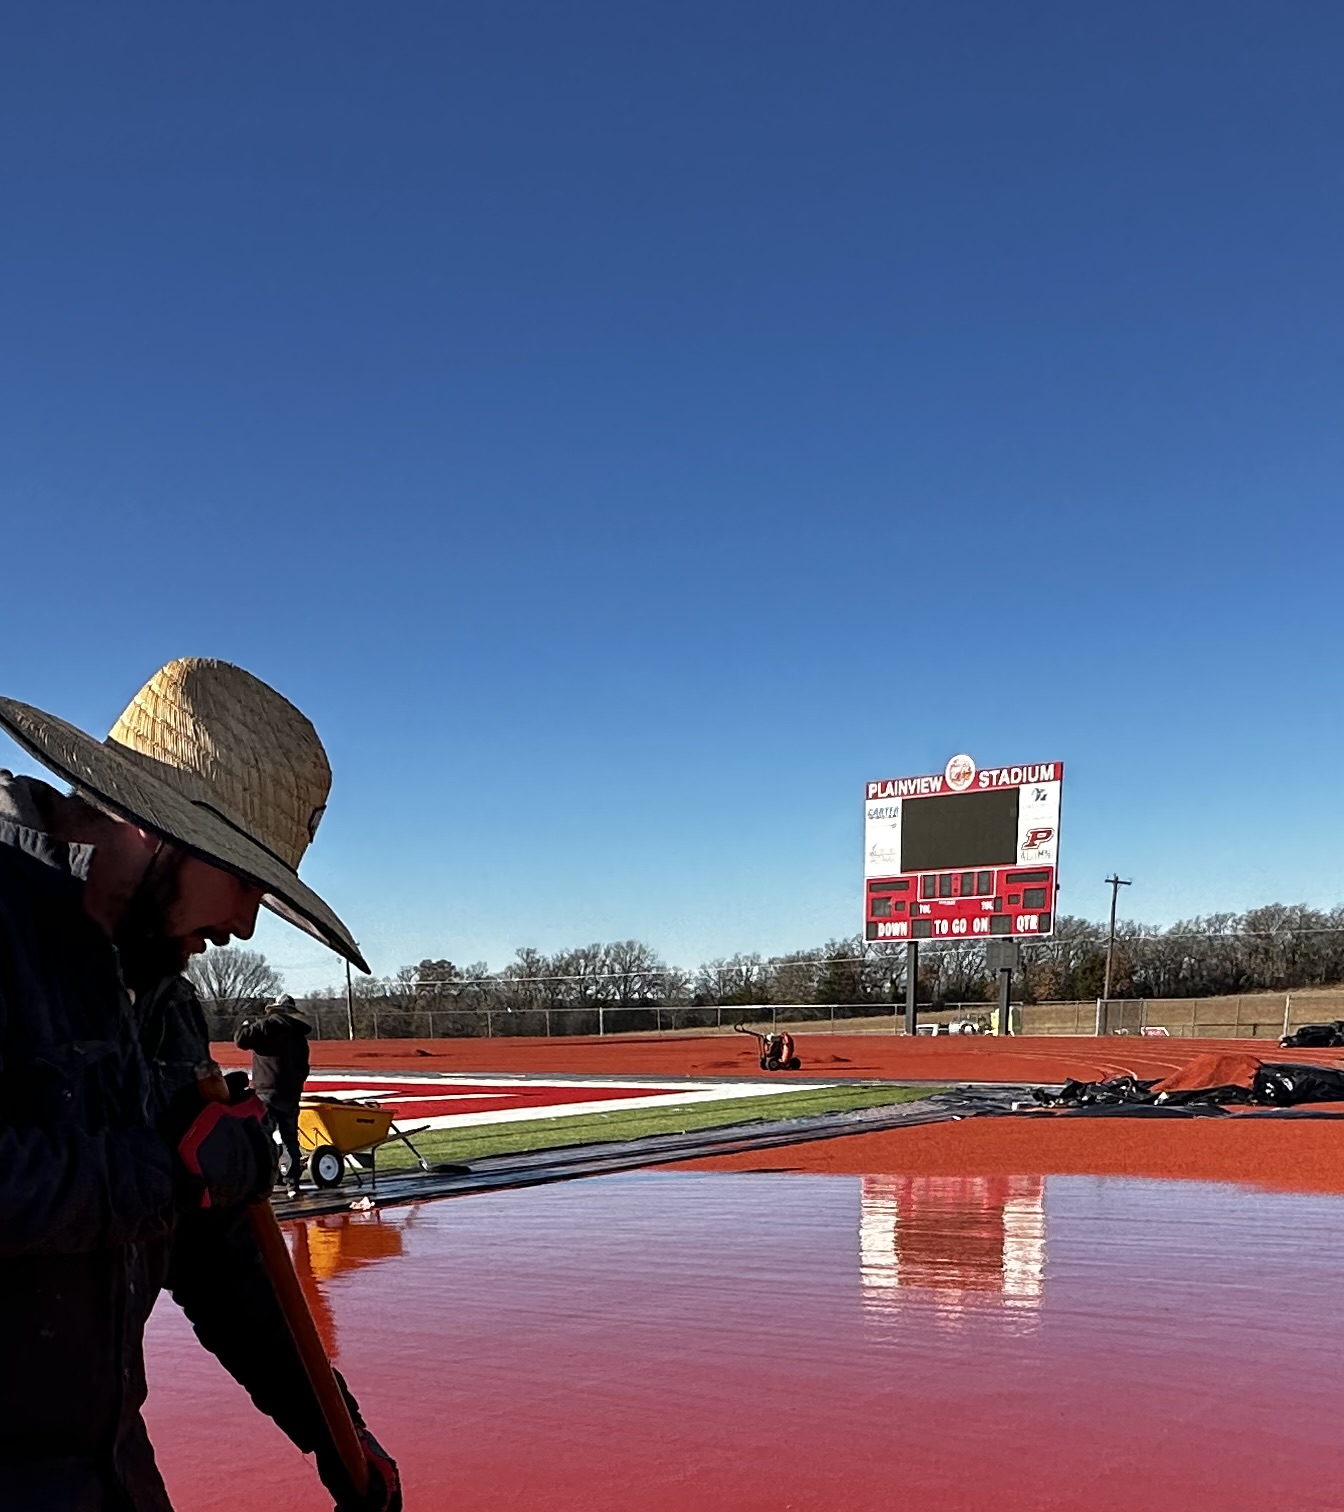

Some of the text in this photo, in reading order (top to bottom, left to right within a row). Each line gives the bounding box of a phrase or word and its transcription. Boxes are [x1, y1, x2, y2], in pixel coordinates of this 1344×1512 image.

[867, 764, 1054, 798] PLAINVIEW STADIUM
[1021, 828, 1055, 850] P
[877, 922, 908, 937] DOWN
[934, 918, 967, 934] TO GO
[973, 917, 989, 933] ON
[1016, 915, 1038, 931] QTR
